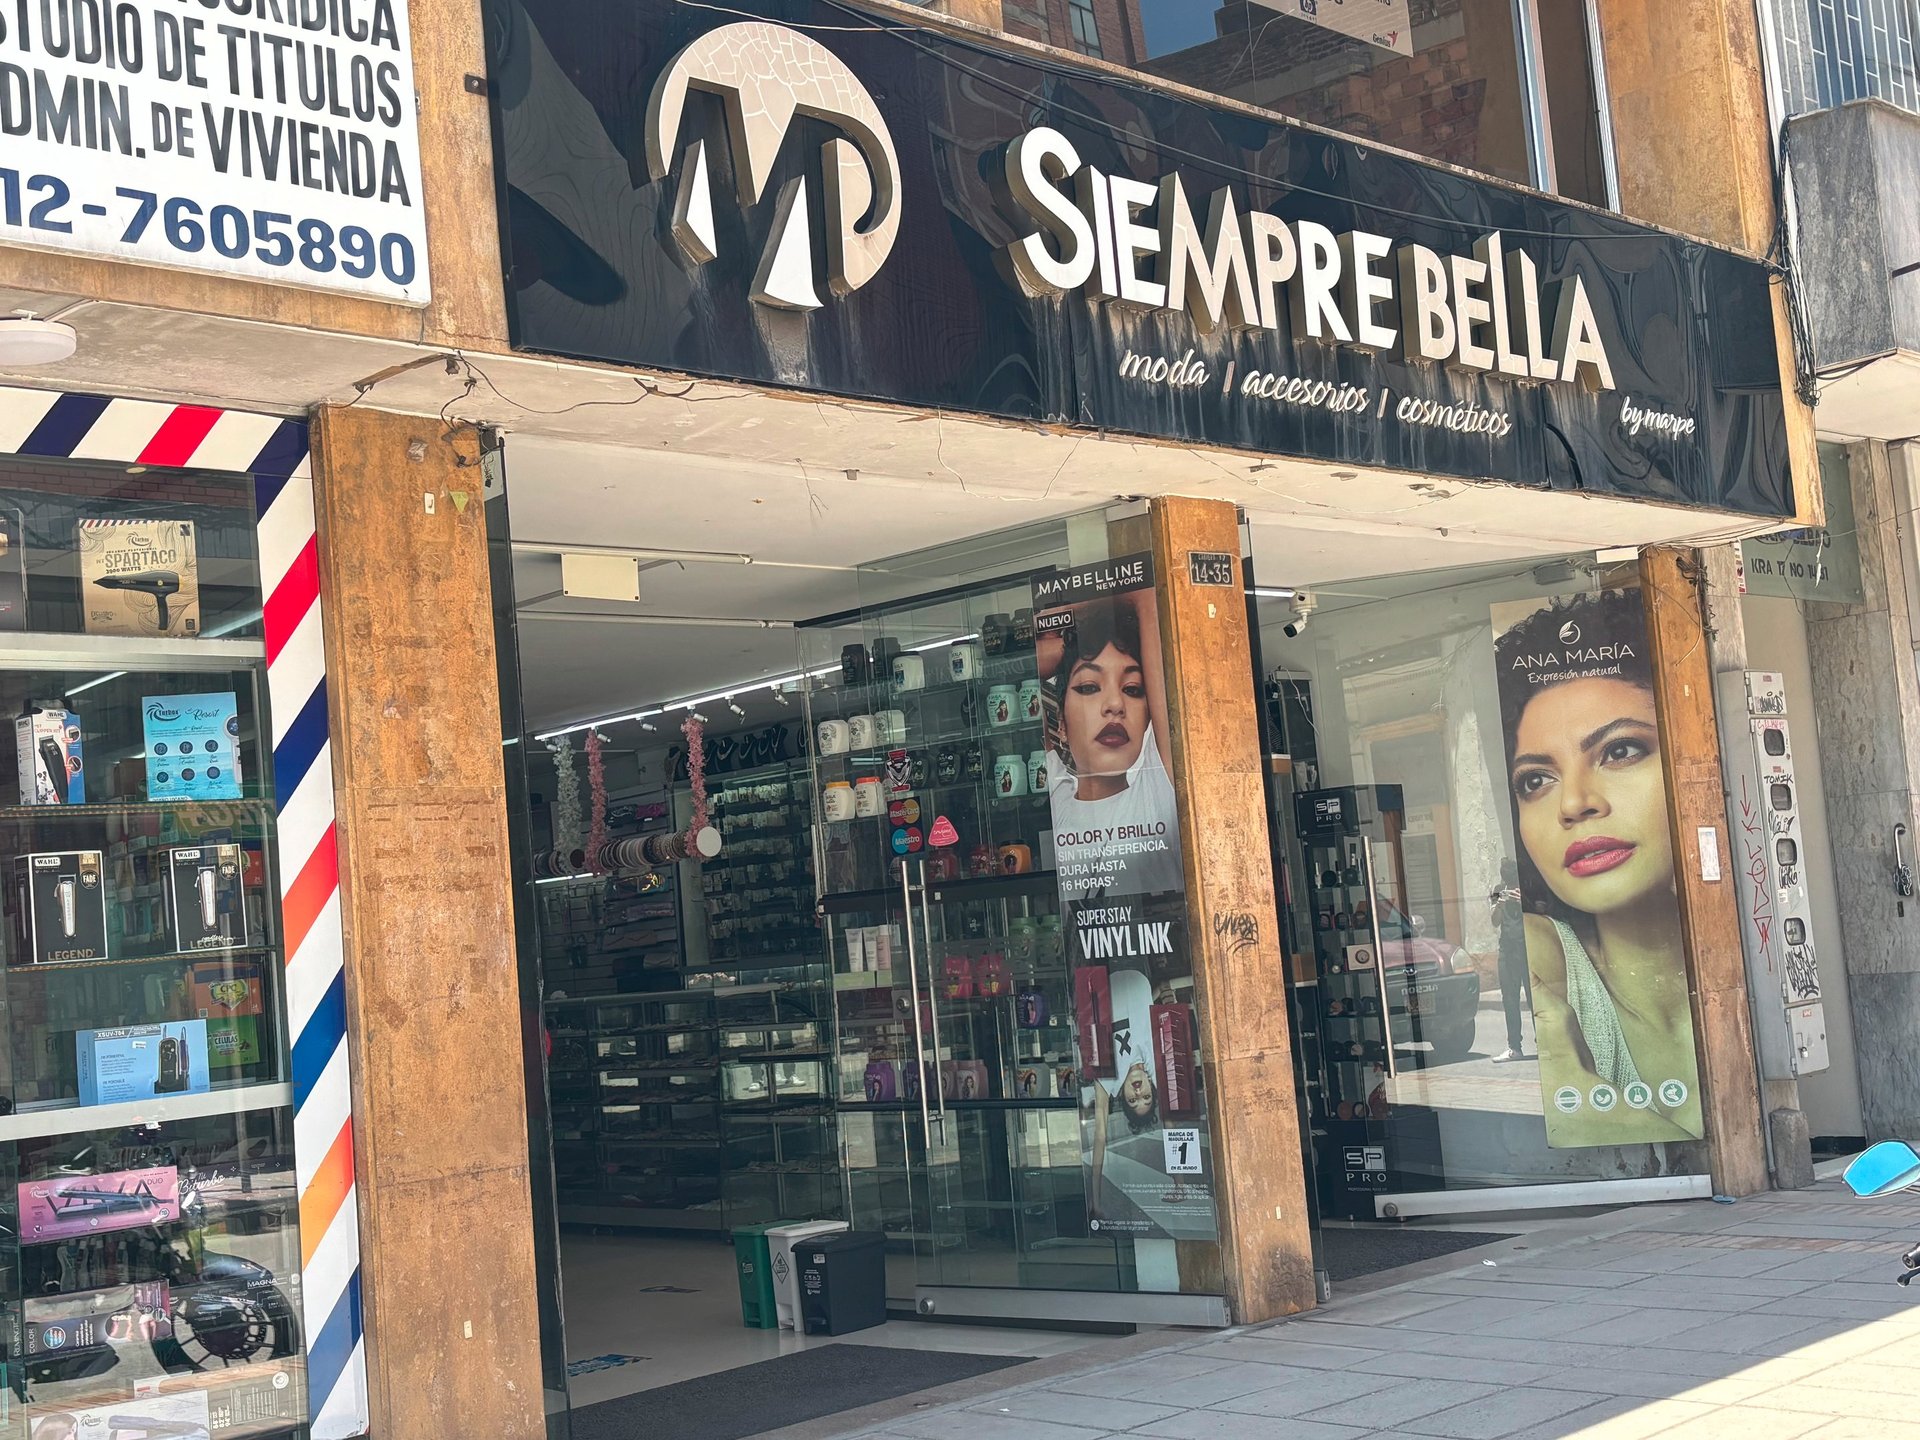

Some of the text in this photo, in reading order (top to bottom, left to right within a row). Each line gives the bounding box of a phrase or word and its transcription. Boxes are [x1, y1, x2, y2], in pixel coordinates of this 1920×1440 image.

[0, 0, 401, 128] TUDIO DE TITULOS
[151, 102, 195, 158] DE
[201, 102, 412, 207] VIVIENDA
[1019, 126, 1616, 391] SIEMPRE BELLA
[1119, 348, 1513, 437] moda accesorios cosméticos
[1619, 395, 1643, 435] by
[105, 549, 177, 568] SPARTACO
[1751, 558, 1773, 575] KRA
[1789, 562, 1804, 578] NO
[1038, 561, 1144, 596] MAYBELLINE
[1096, 575, 1144, 591] NEW YORK
[1194, 562, 1230, 584] 14-35
[1038, 613, 1072, 629] NUEVO
[1512, 642, 1635, 670] ANA MARÍA
[1527, 663, 1622, 685] Expresión natural
[1316, 814, 1342, 822] PRO
[1057, 821, 1167, 847] COLOR Y BRILLO
[1058, 839, 1169, 862] SIN TRANSFERENCIA.
[83, 874, 97, 883] FADE
[1060, 860, 1127, 876] DURA HASTA
[1061, 881, 1073, 891] 16
[1077, 905, 1132, 926] SUPER STAY
[190, 937, 234, 949] LEGEND
[1078, 925, 1137, 959] VINYL
[1138, 921, 1174, 955] INK
[47, 949, 93, 961] LEGEND
[178, 1169, 226, 1196] Biturbo
[1346, 1172, 1387, 1182] PRO
[247, 1277, 278, 1288] MAGNA
